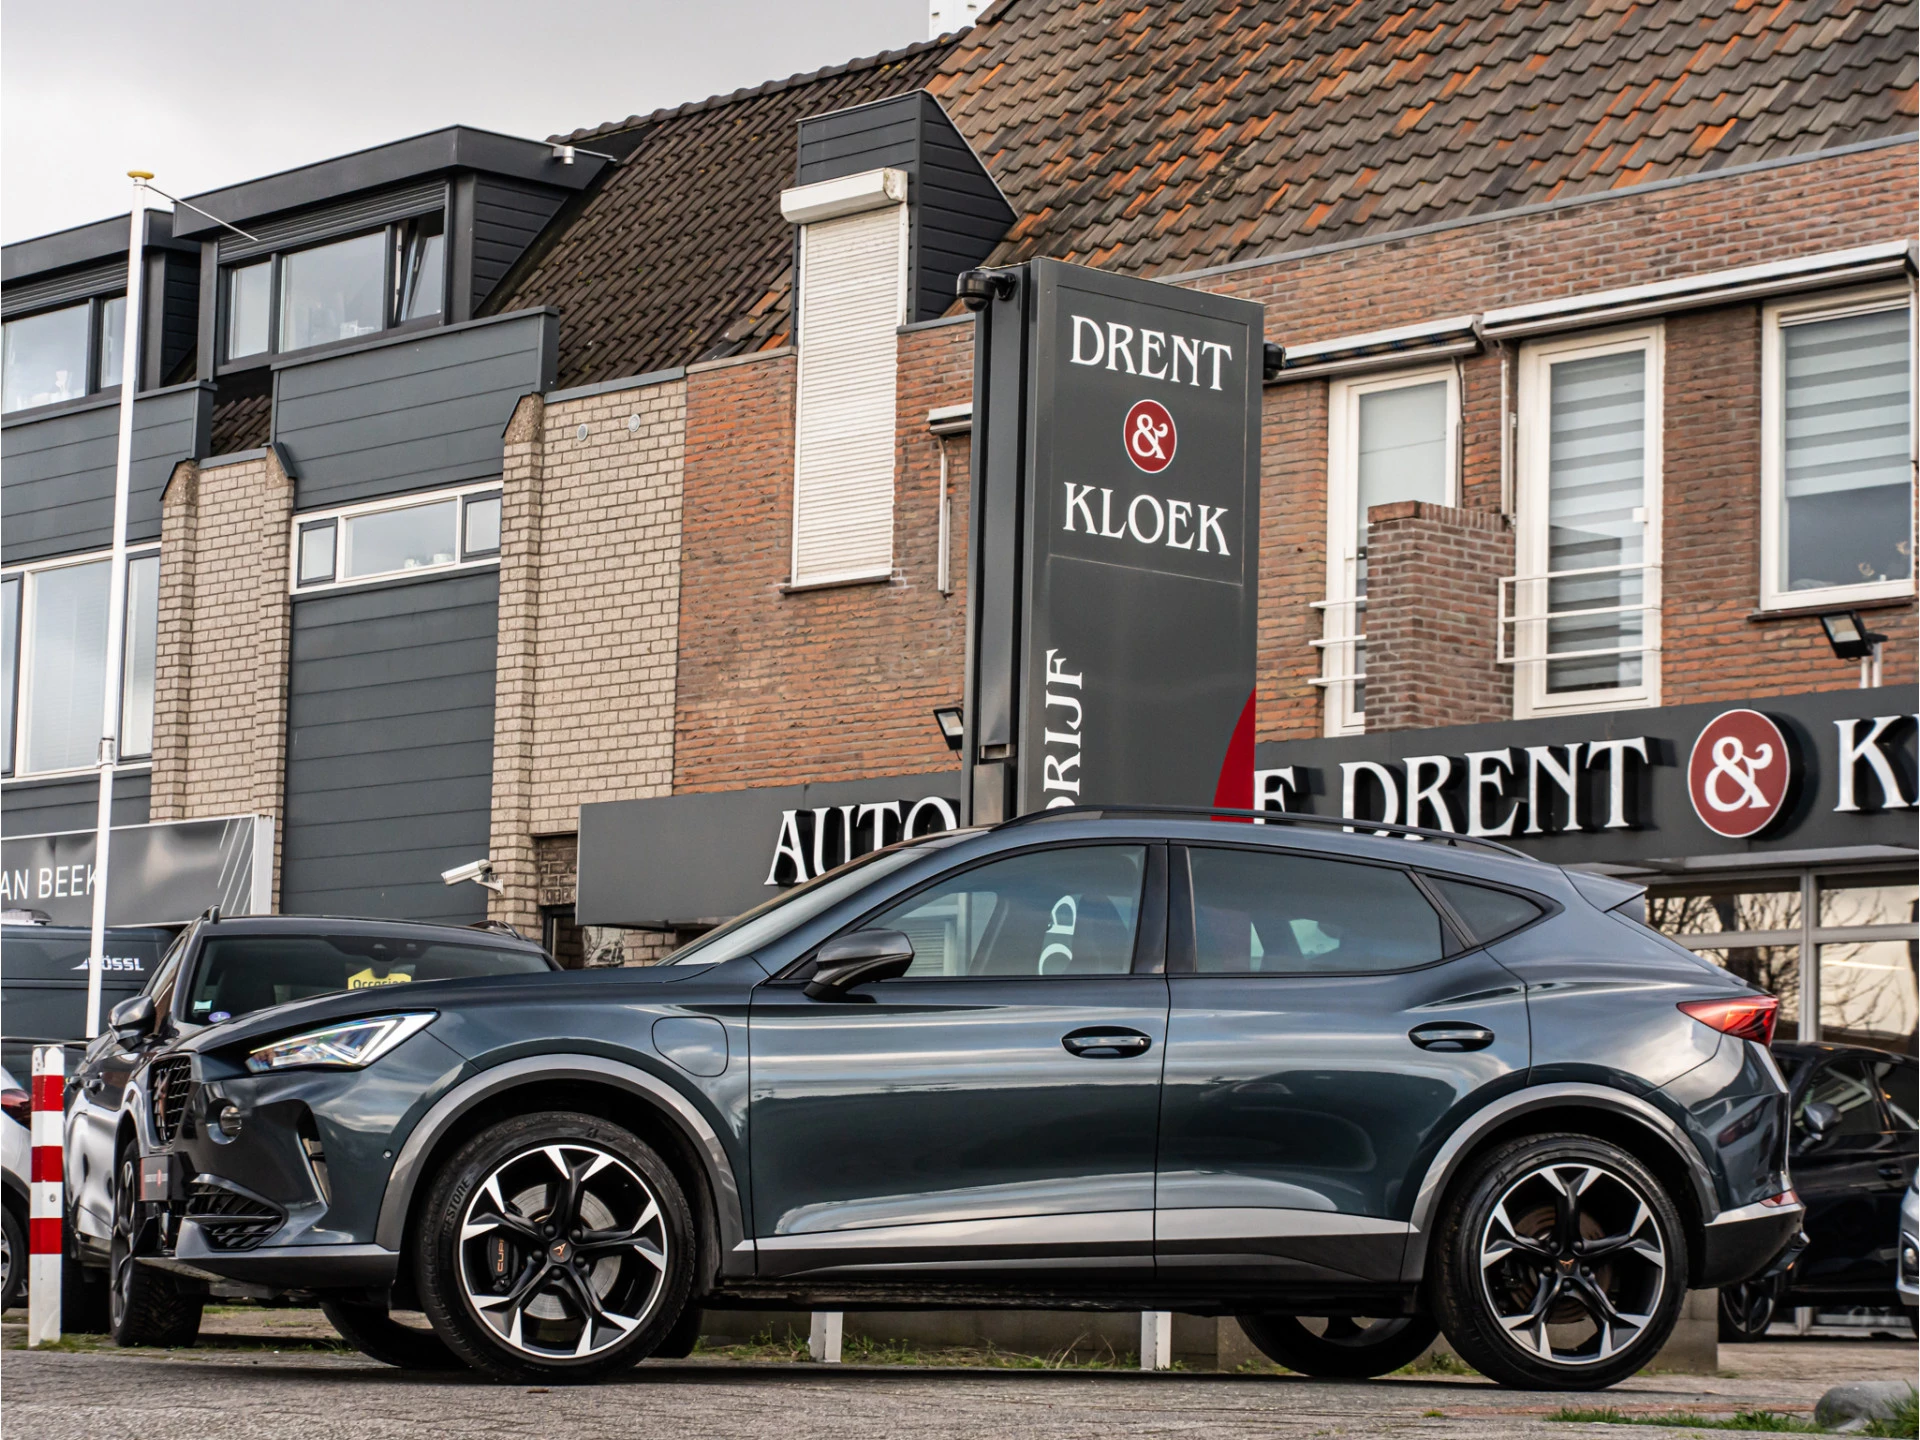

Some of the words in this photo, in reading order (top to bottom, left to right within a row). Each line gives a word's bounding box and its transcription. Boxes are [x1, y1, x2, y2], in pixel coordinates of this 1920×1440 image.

[1070, 315, 1232, 391] DRENT
[1131, 413, 1168, 459] &
[1063, 482, 1231, 556] KLOEK
[1339, 736, 1649, 840] DRENT
[1704, 736, 1773, 812] &
[1833, 713, 1919, 812] K
[87, 955, 145, 971] ÖSSL
